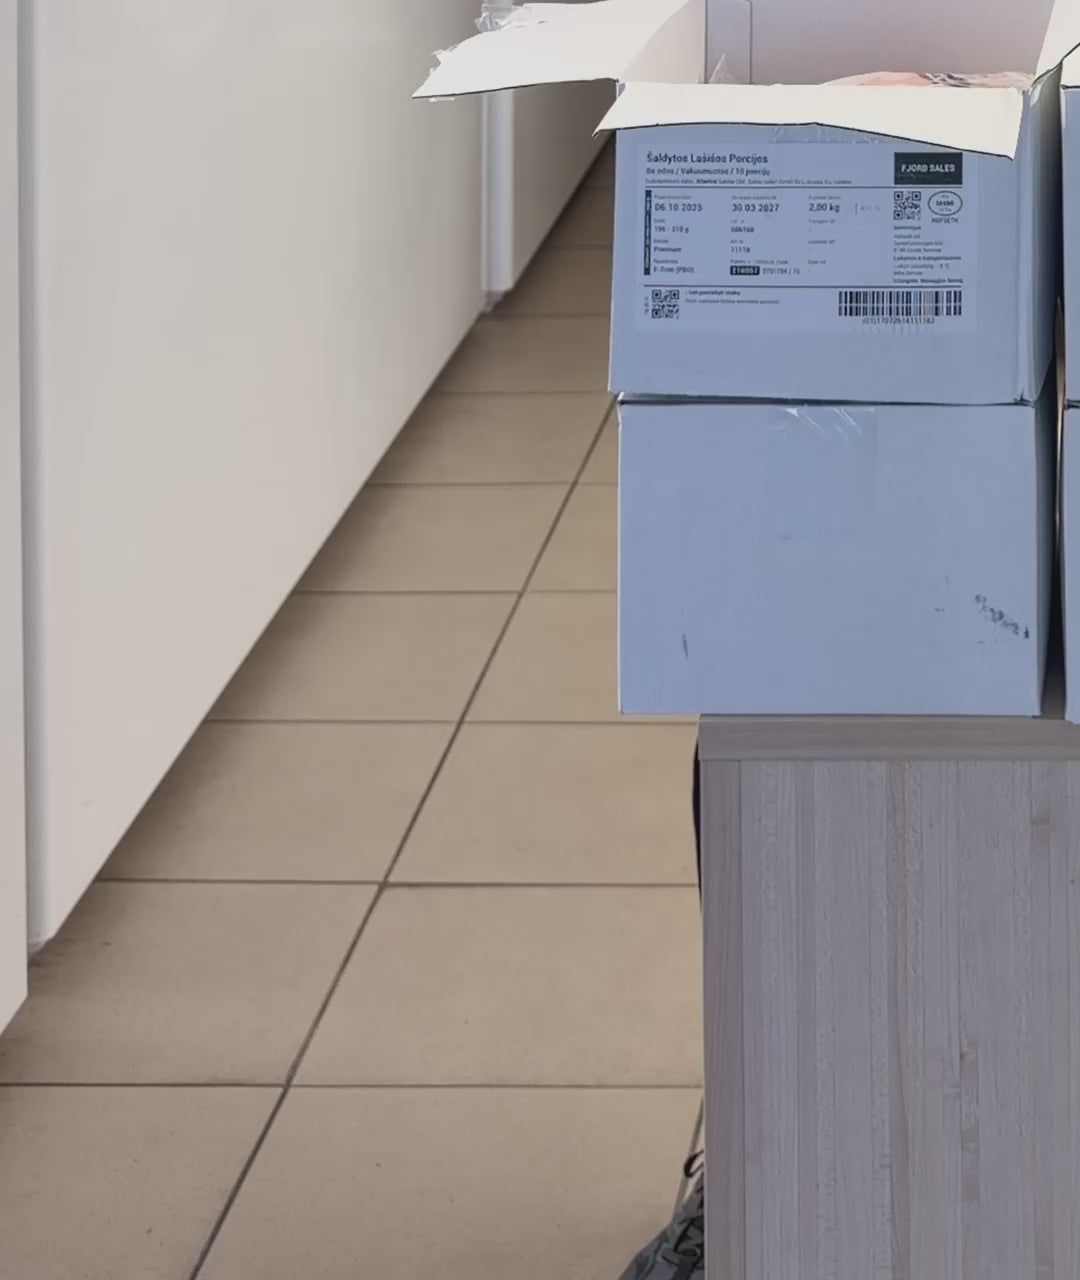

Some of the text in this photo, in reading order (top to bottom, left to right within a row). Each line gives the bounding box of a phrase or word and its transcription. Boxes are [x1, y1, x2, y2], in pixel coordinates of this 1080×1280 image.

[646, 151, 768, 166] Šaldytos Lašišos Porcijos
[901, 164, 956, 173] FJORD SALES
[808, 203, 840, 213] 2,00 kg
